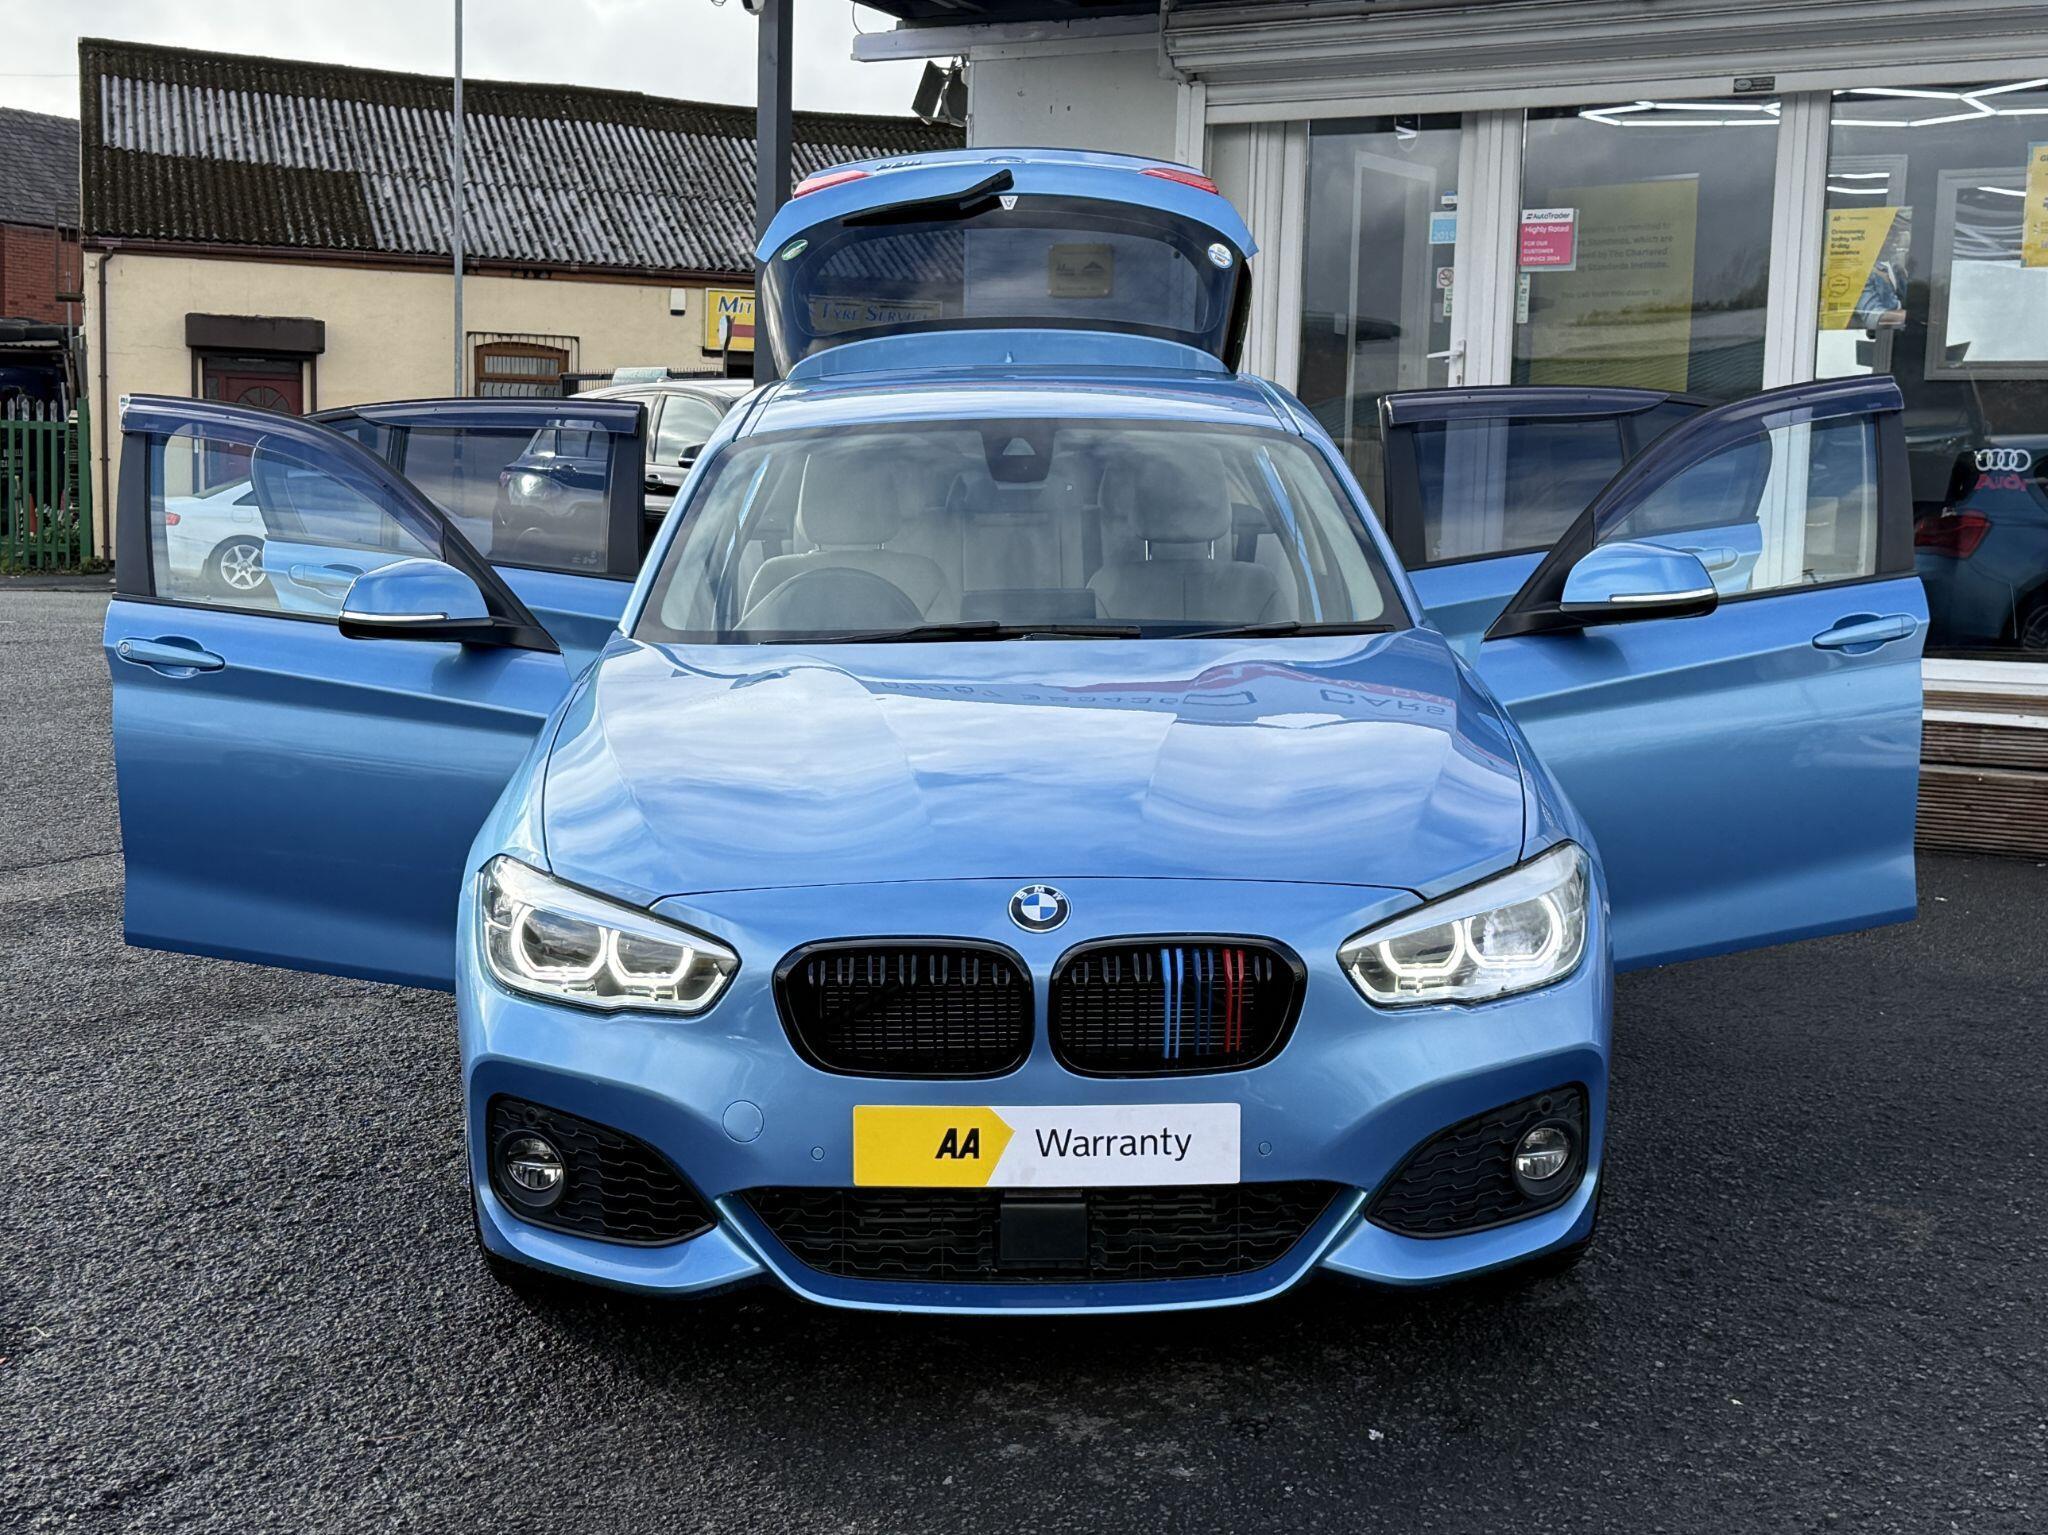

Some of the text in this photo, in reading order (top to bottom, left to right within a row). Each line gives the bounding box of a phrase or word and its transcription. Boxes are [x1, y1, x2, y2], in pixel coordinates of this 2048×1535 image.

[1534, 212, 1570, 220] AutoTrader
[1526, 226, 1547, 235] Highly
[1547, 225, 1570, 233] Rated
[1015, 886, 1064, 900] BMW
[935, 1127, 1192, 1161] AA Warranty
